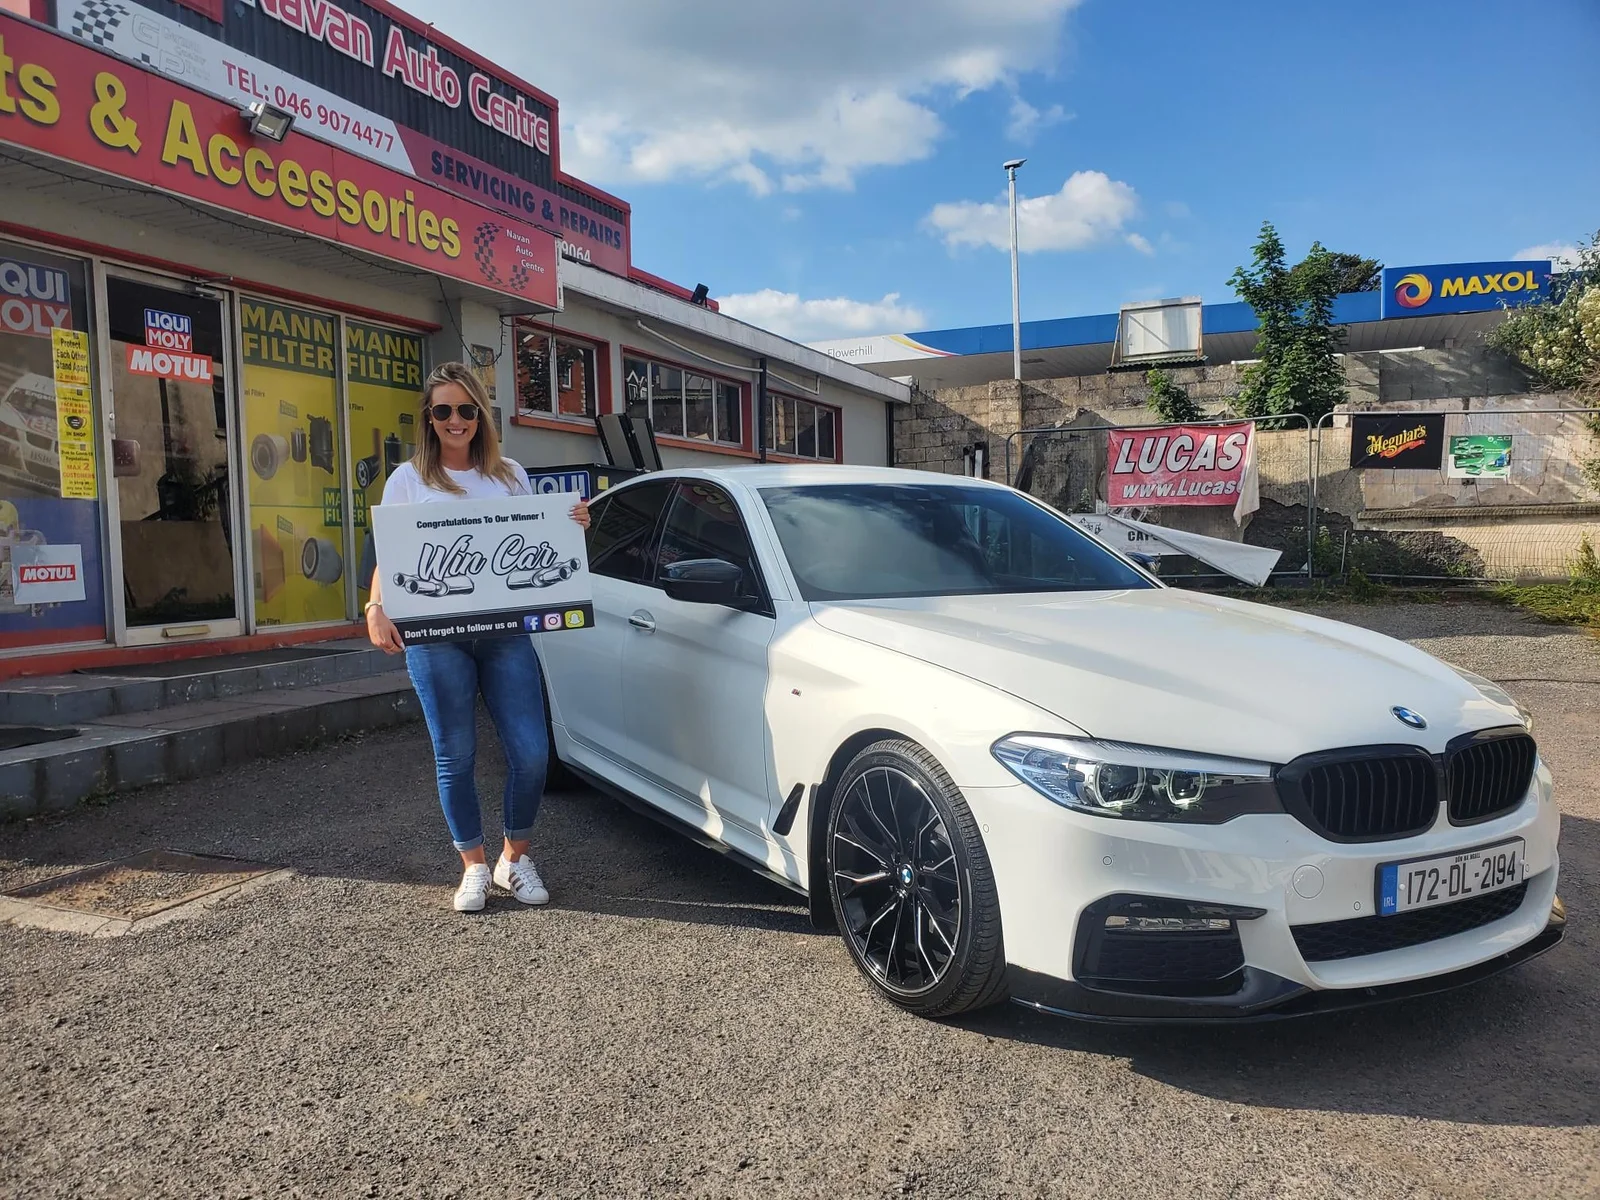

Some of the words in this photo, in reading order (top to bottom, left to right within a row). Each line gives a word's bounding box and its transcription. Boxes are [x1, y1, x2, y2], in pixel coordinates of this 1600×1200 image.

[240, 0, 374, 68] avan
[382, 24, 461, 108] Auto
[468, 72, 550, 156] Centre
[222, 60, 270, 101] TEL:
[274, 85, 313, 120] 046
[317, 104, 394, 152] 9074477
[90, 71, 142, 154] &
[162, 99, 461, 258] Accessories
[431, 150, 536, 214] SERVICING
[541, 198, 555, 223] &
[559, 205, 622, 251] REPAIRS
[506, 228, 531, 245] Navan
[515, 245, 534, 259] Auto
[521, 258, 545, 274] Centre
[0, 262, 65, 302] QUI
[1440, 270, 1540, 298] MAXOL
[147, 311, 189, 332] LIQUI
[241, 303, 333, 345] MANN
[57, 348, 70, 359] Each
[60, 338, 81, 349] Protect
[148, 329, 191, 350] MOLY
[243, 331, 334, 371] FILTER
[345, 326, 420, 362] MANN
[827, 344, 873, 358] Flowerhill
[130, 349, 211, 380] MOTUL
[347, 353, 421, 386] FILTER
[1113, 432, 1247, 475] LUCAS
[1366, 424, 1427, 456] Meguiar's
[325, 491, 364, 507] MAN
[326, 508, 365, 523] FILER
[416, 516, 482, 529] Congratulations
[484, 516, 493, 524] To
[495, 514, 509, 523] Our
[510, 513, 539, 522] Winner
[417, 534, 487, 581] Win
[491, 533, 558, 576] Car
[23, 567, 74, 580] MOTUL
[404, 628, 427, 639] Don't
[428, 626, 454, 637] forget
[456, 625, 465, 634] to
[467, 623, 493, 633] follow
[507, 621, 517, 629] on
[1383, 896, 1395, 908] IRL
[1407, 850, 1516, 905] 172-DL-2194
